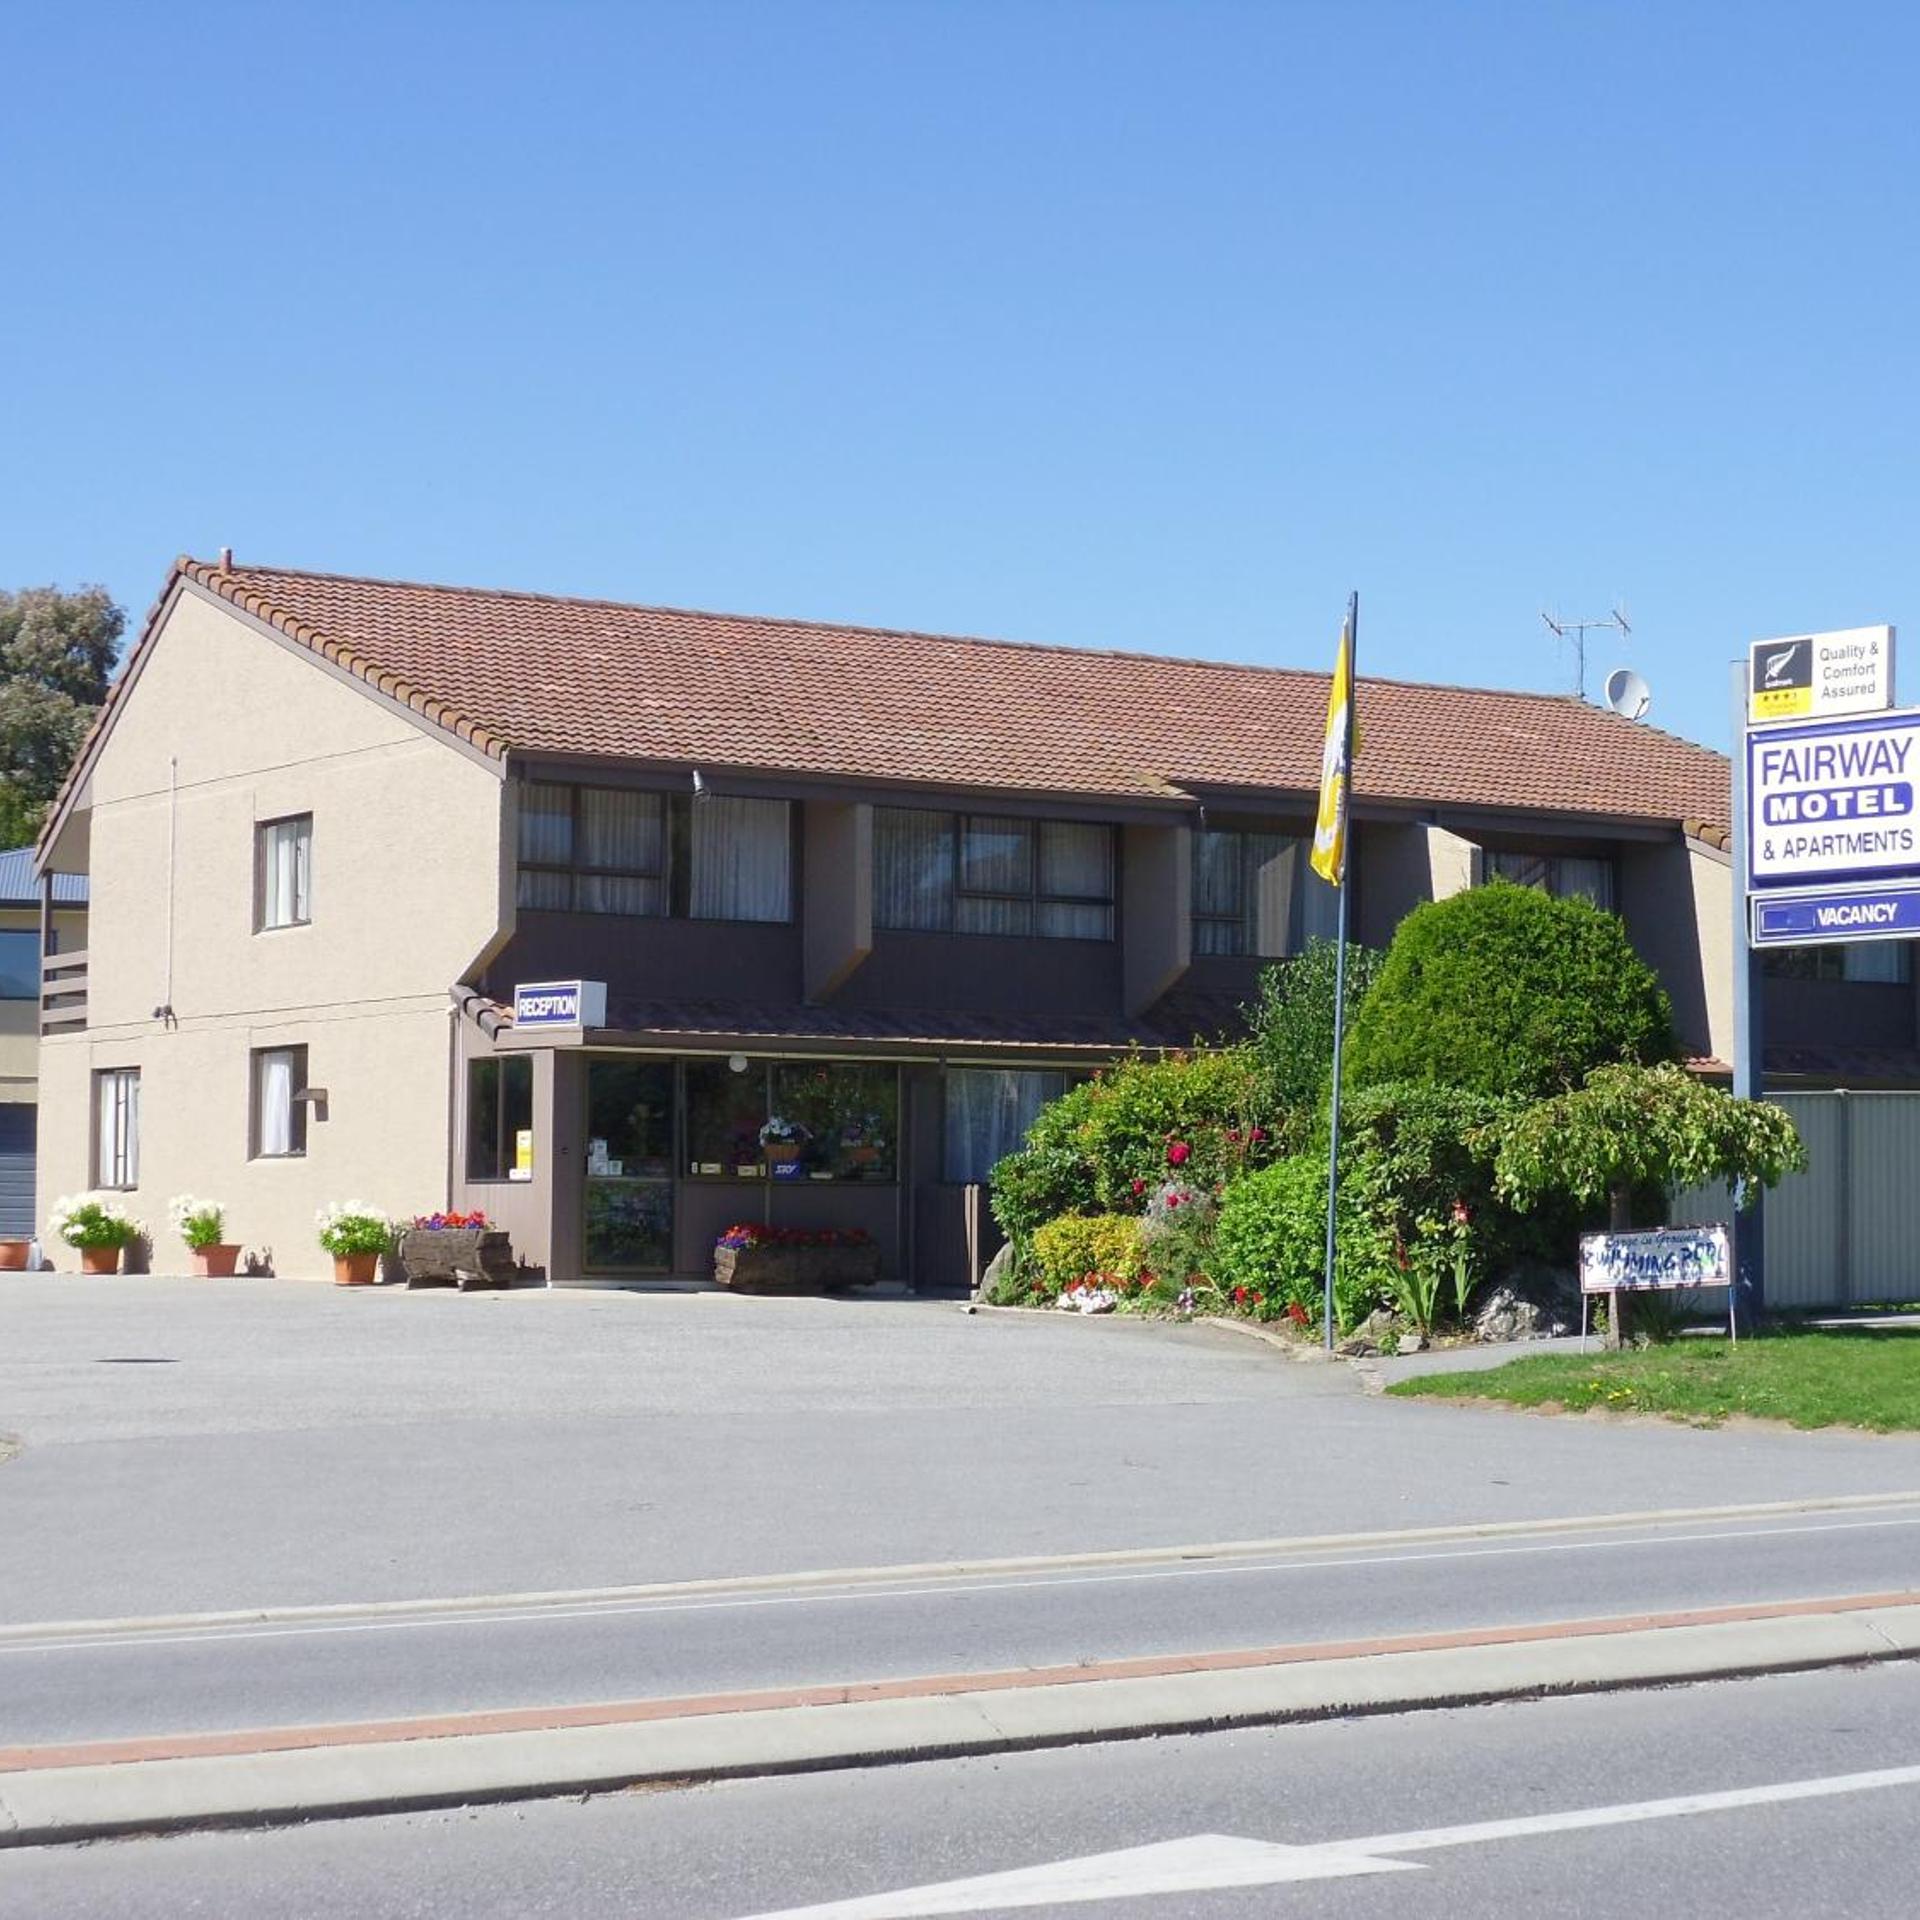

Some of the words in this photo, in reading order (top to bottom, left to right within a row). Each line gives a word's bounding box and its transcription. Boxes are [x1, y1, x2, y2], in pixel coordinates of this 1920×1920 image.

[1820, 645, 1865, 661] Quality
[1870, 641, 1879, 655] &
[1823, 663, 1876, 680] Comfort
[1821, 680, 1876, 699] Assured
[1763, 737, 1913, 785] FAIRWAY
[1769, 788, 1905, 822] MOTEL
[1763, 840, 1775, 860] &
[1783, 829, 1913, 858] APARTMENTS
[1817, 903, 1898, 926] VACANCY
[519, 995, 577, 1016] RECEPTION
